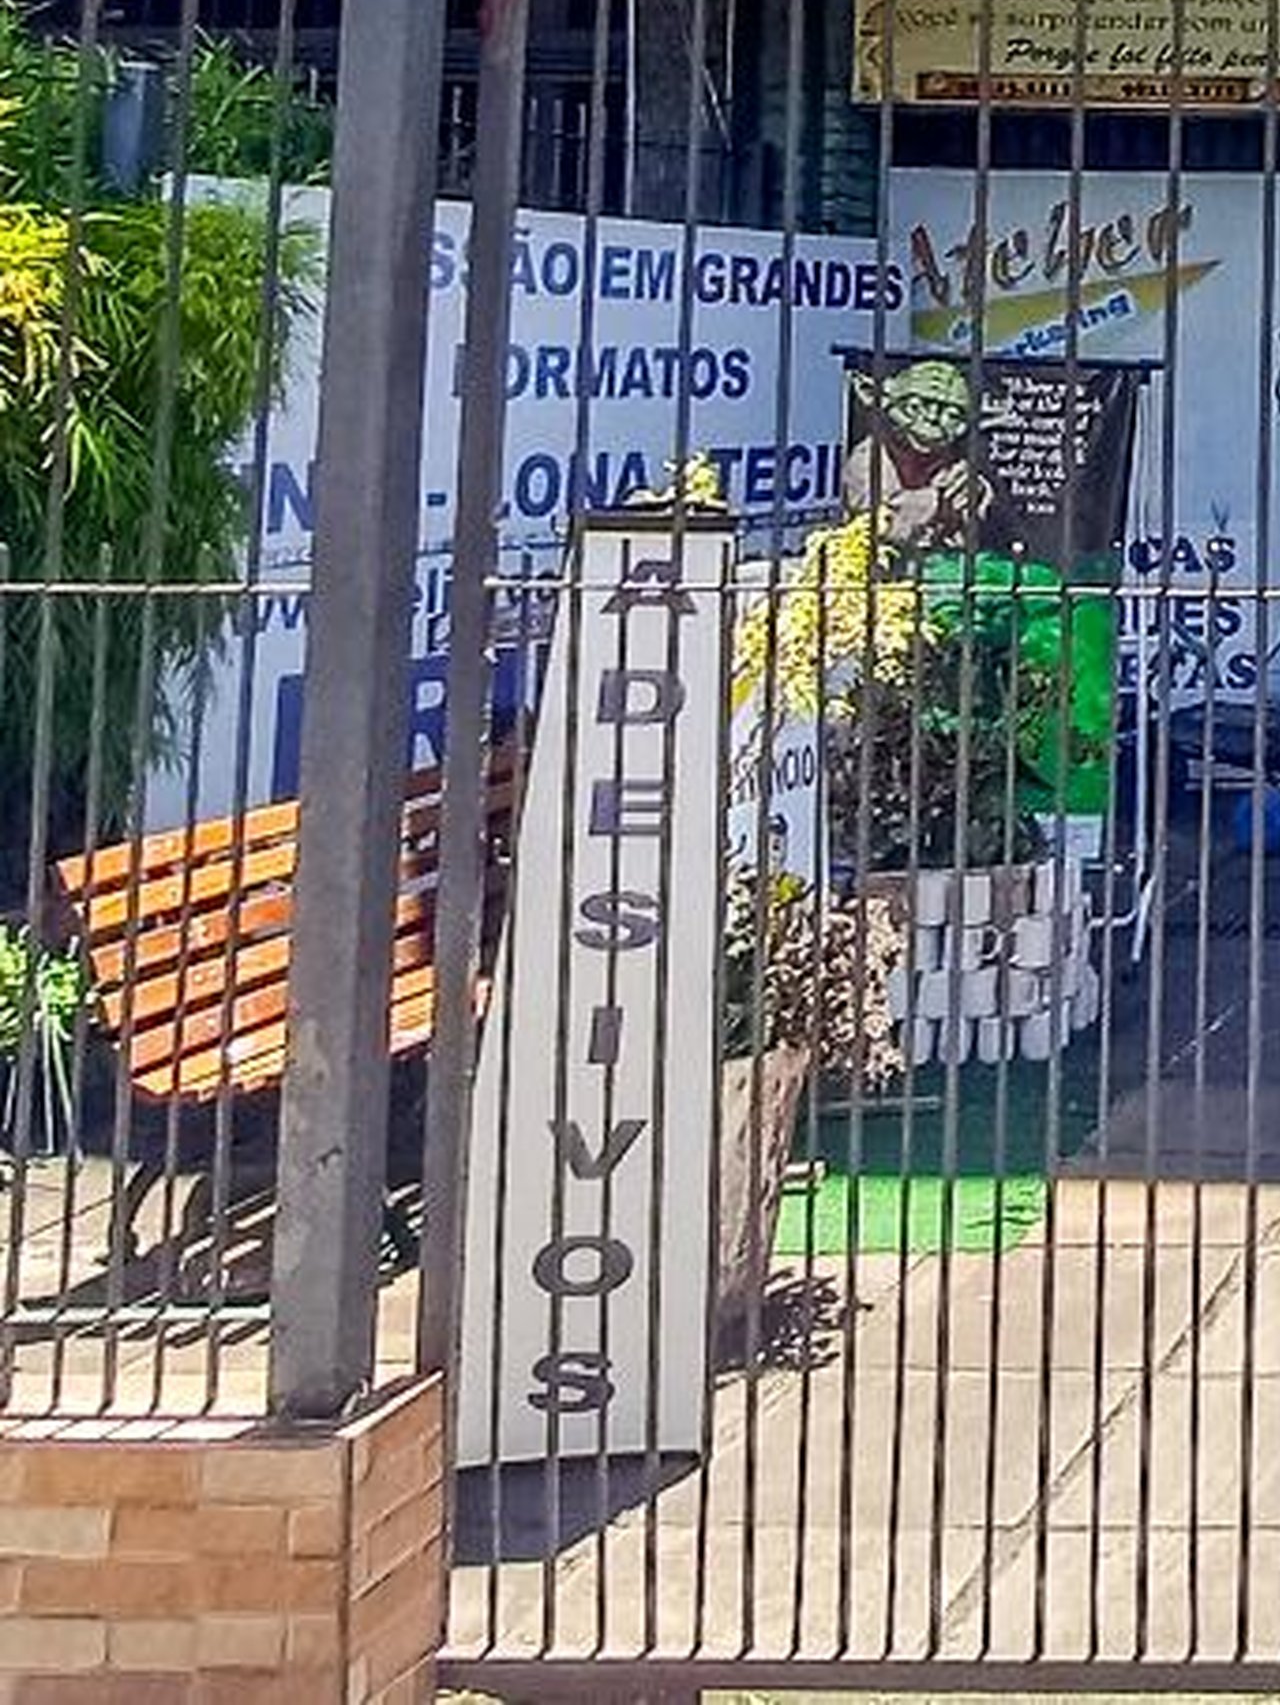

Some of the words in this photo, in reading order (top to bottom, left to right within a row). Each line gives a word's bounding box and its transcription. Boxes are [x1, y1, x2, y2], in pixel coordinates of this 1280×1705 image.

[600, 245, 675, 301] EM
[698, 252, 905, 311] GRANDES
[527, 559, 697, 1414] ADESIVOS
